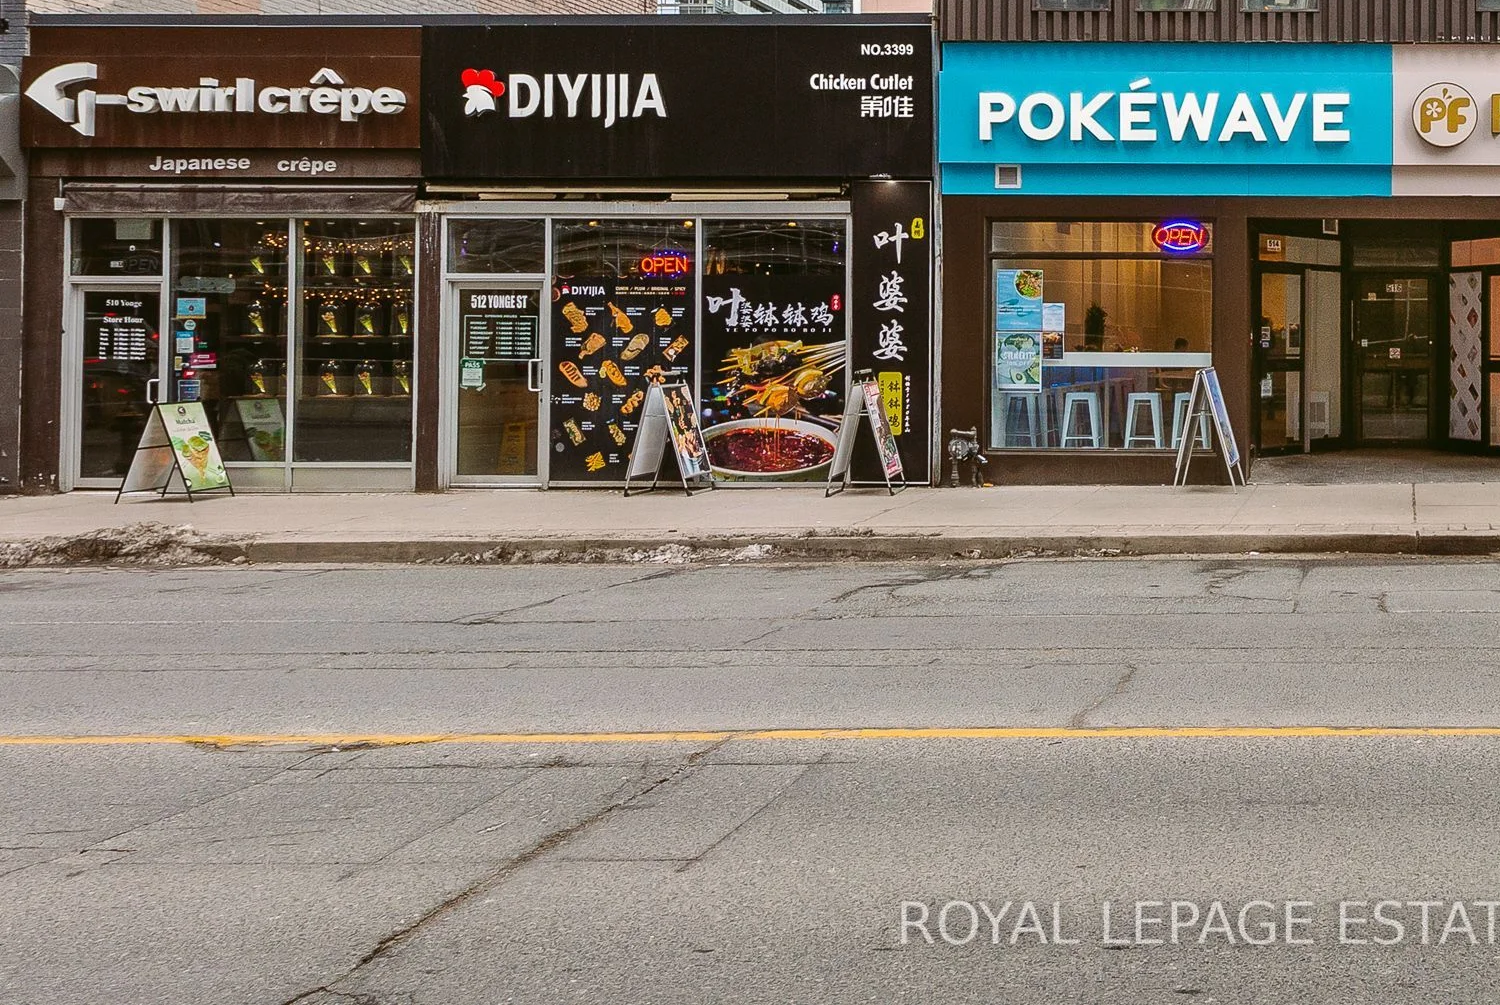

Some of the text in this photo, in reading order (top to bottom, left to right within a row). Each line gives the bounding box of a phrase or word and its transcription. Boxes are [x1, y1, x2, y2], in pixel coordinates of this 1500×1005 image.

[861, 43, 914, 56] NO.3399
[810, 73, 914, 90] Chicken Cutlet
[508, 73, 668, 128] DIYIJIA
[978, 76, 1351, 143] POKÉWAVE
[150, 155, 337, 175] Japanese crêpe
[1155, 227, 1205, 247] OPEN
[641, 257, 688, 272] OPEN
[571, 286, 605, 296] DIYIJIA
[471, 295, 528, 308] 512 YONGE ST
